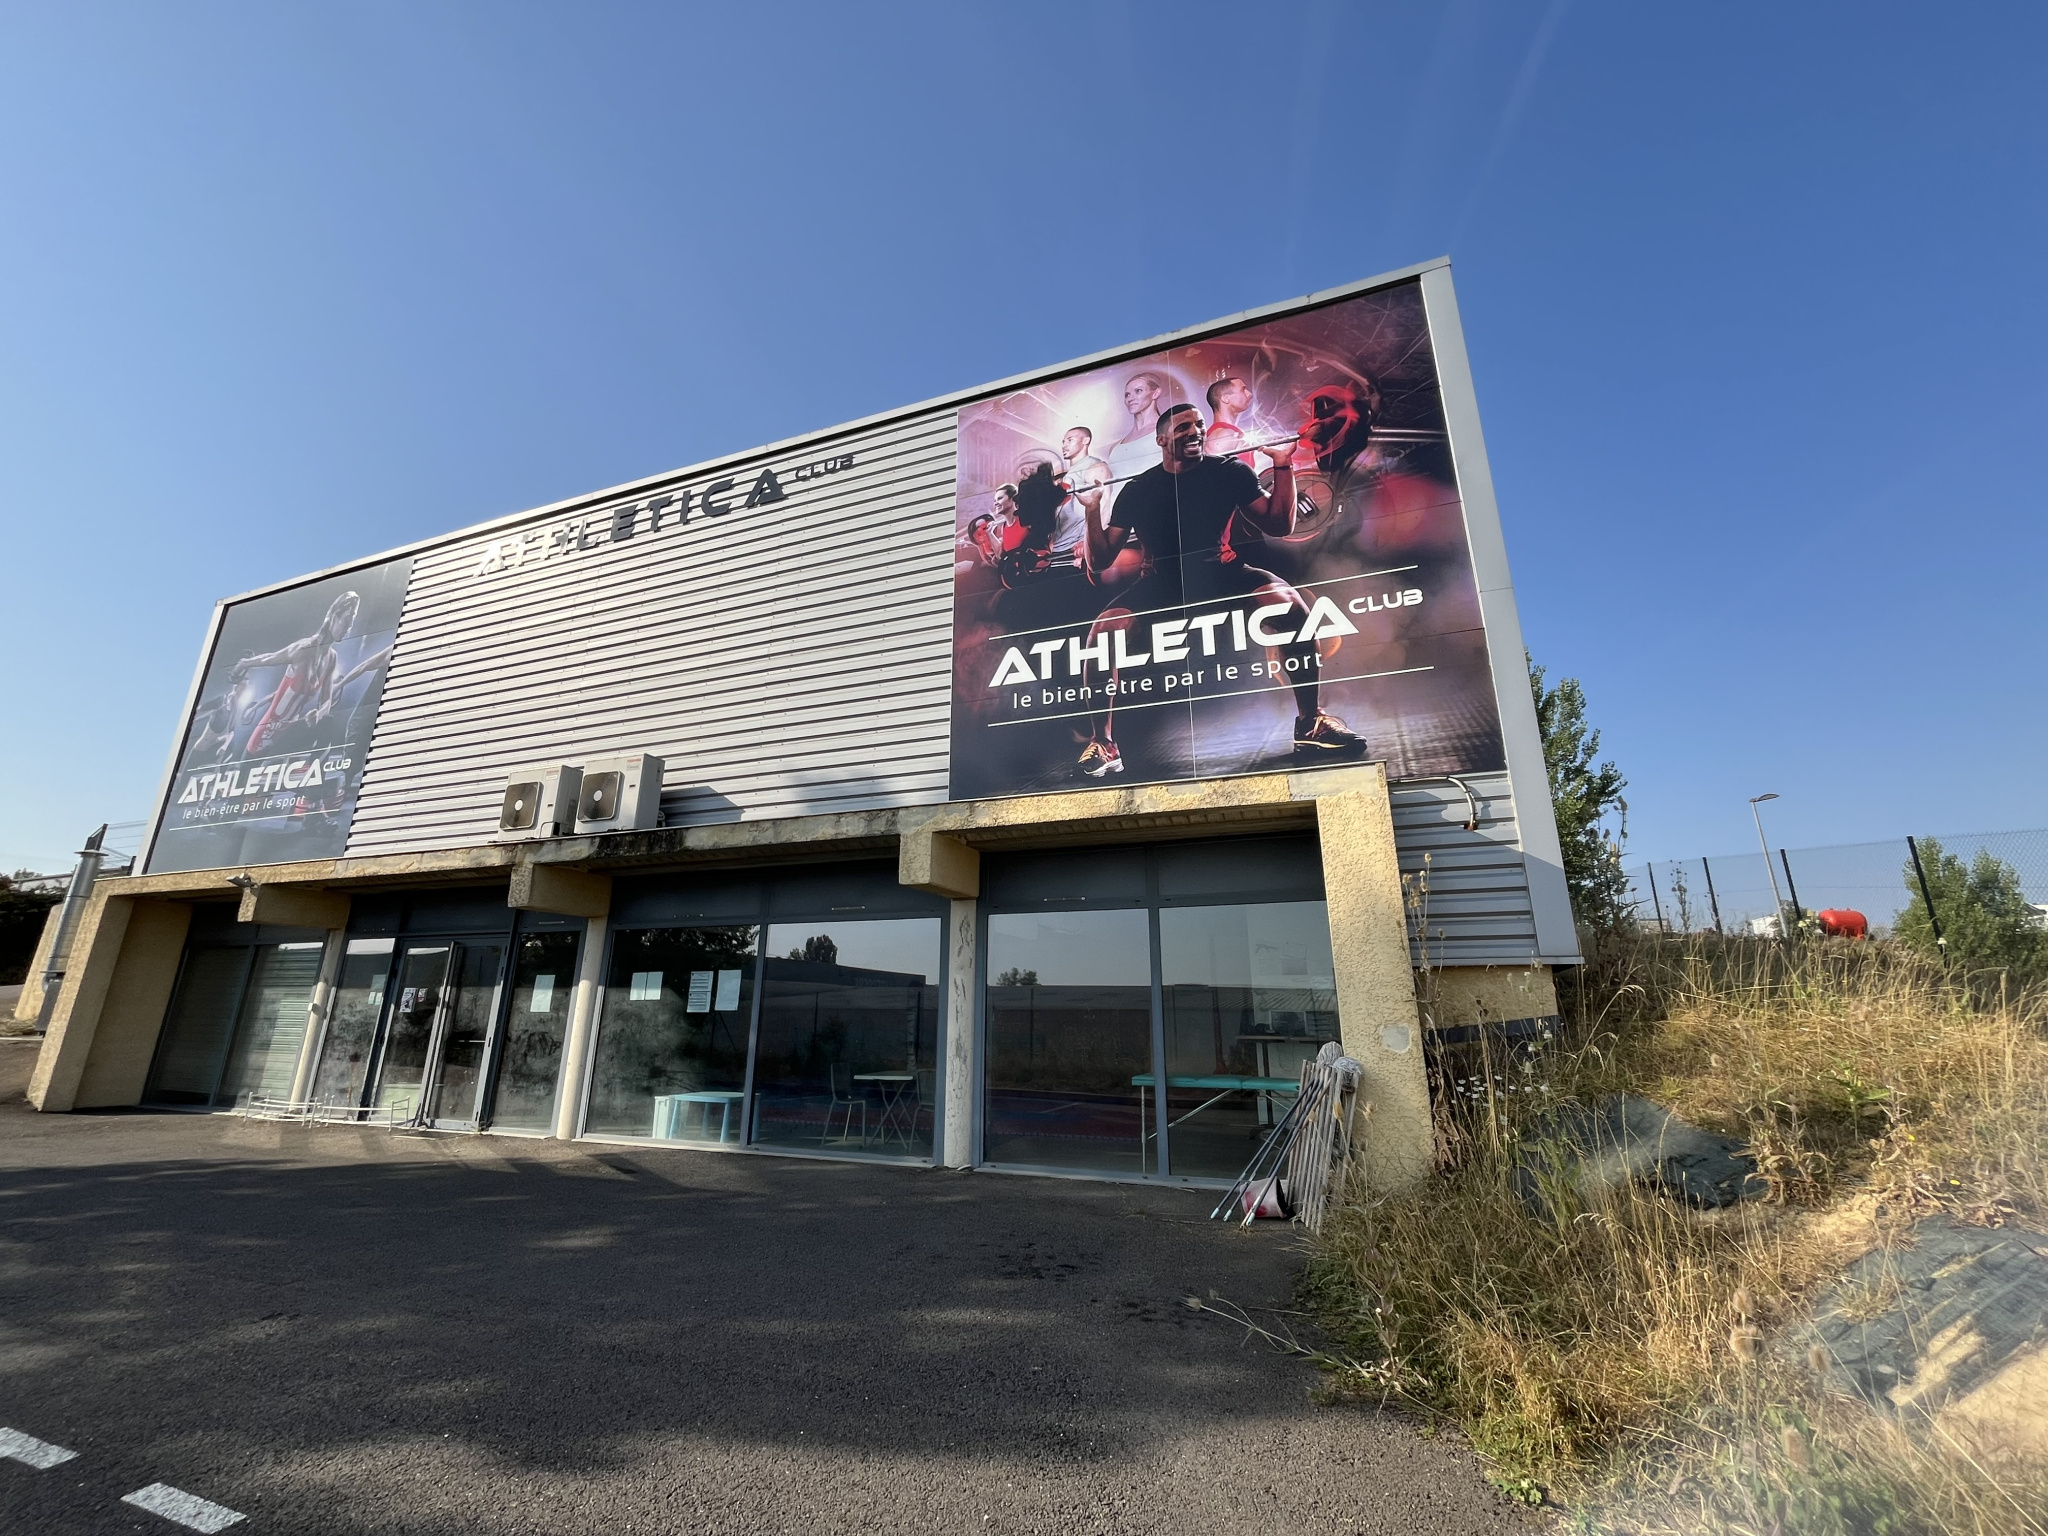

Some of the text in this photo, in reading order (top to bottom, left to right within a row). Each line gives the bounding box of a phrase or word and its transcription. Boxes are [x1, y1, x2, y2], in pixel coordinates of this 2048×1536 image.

[473, 453, 855, 577] ATHLETICA CLUB
[988, 588, 1424, 688] ATHLETICA CLUB
[1012, 652, 1325, 709] le bien-être par le sport
[177, 758, 352, 804] ATHLETICA CLUB
[182, 795, 306, 820] le bien-être par le sport
